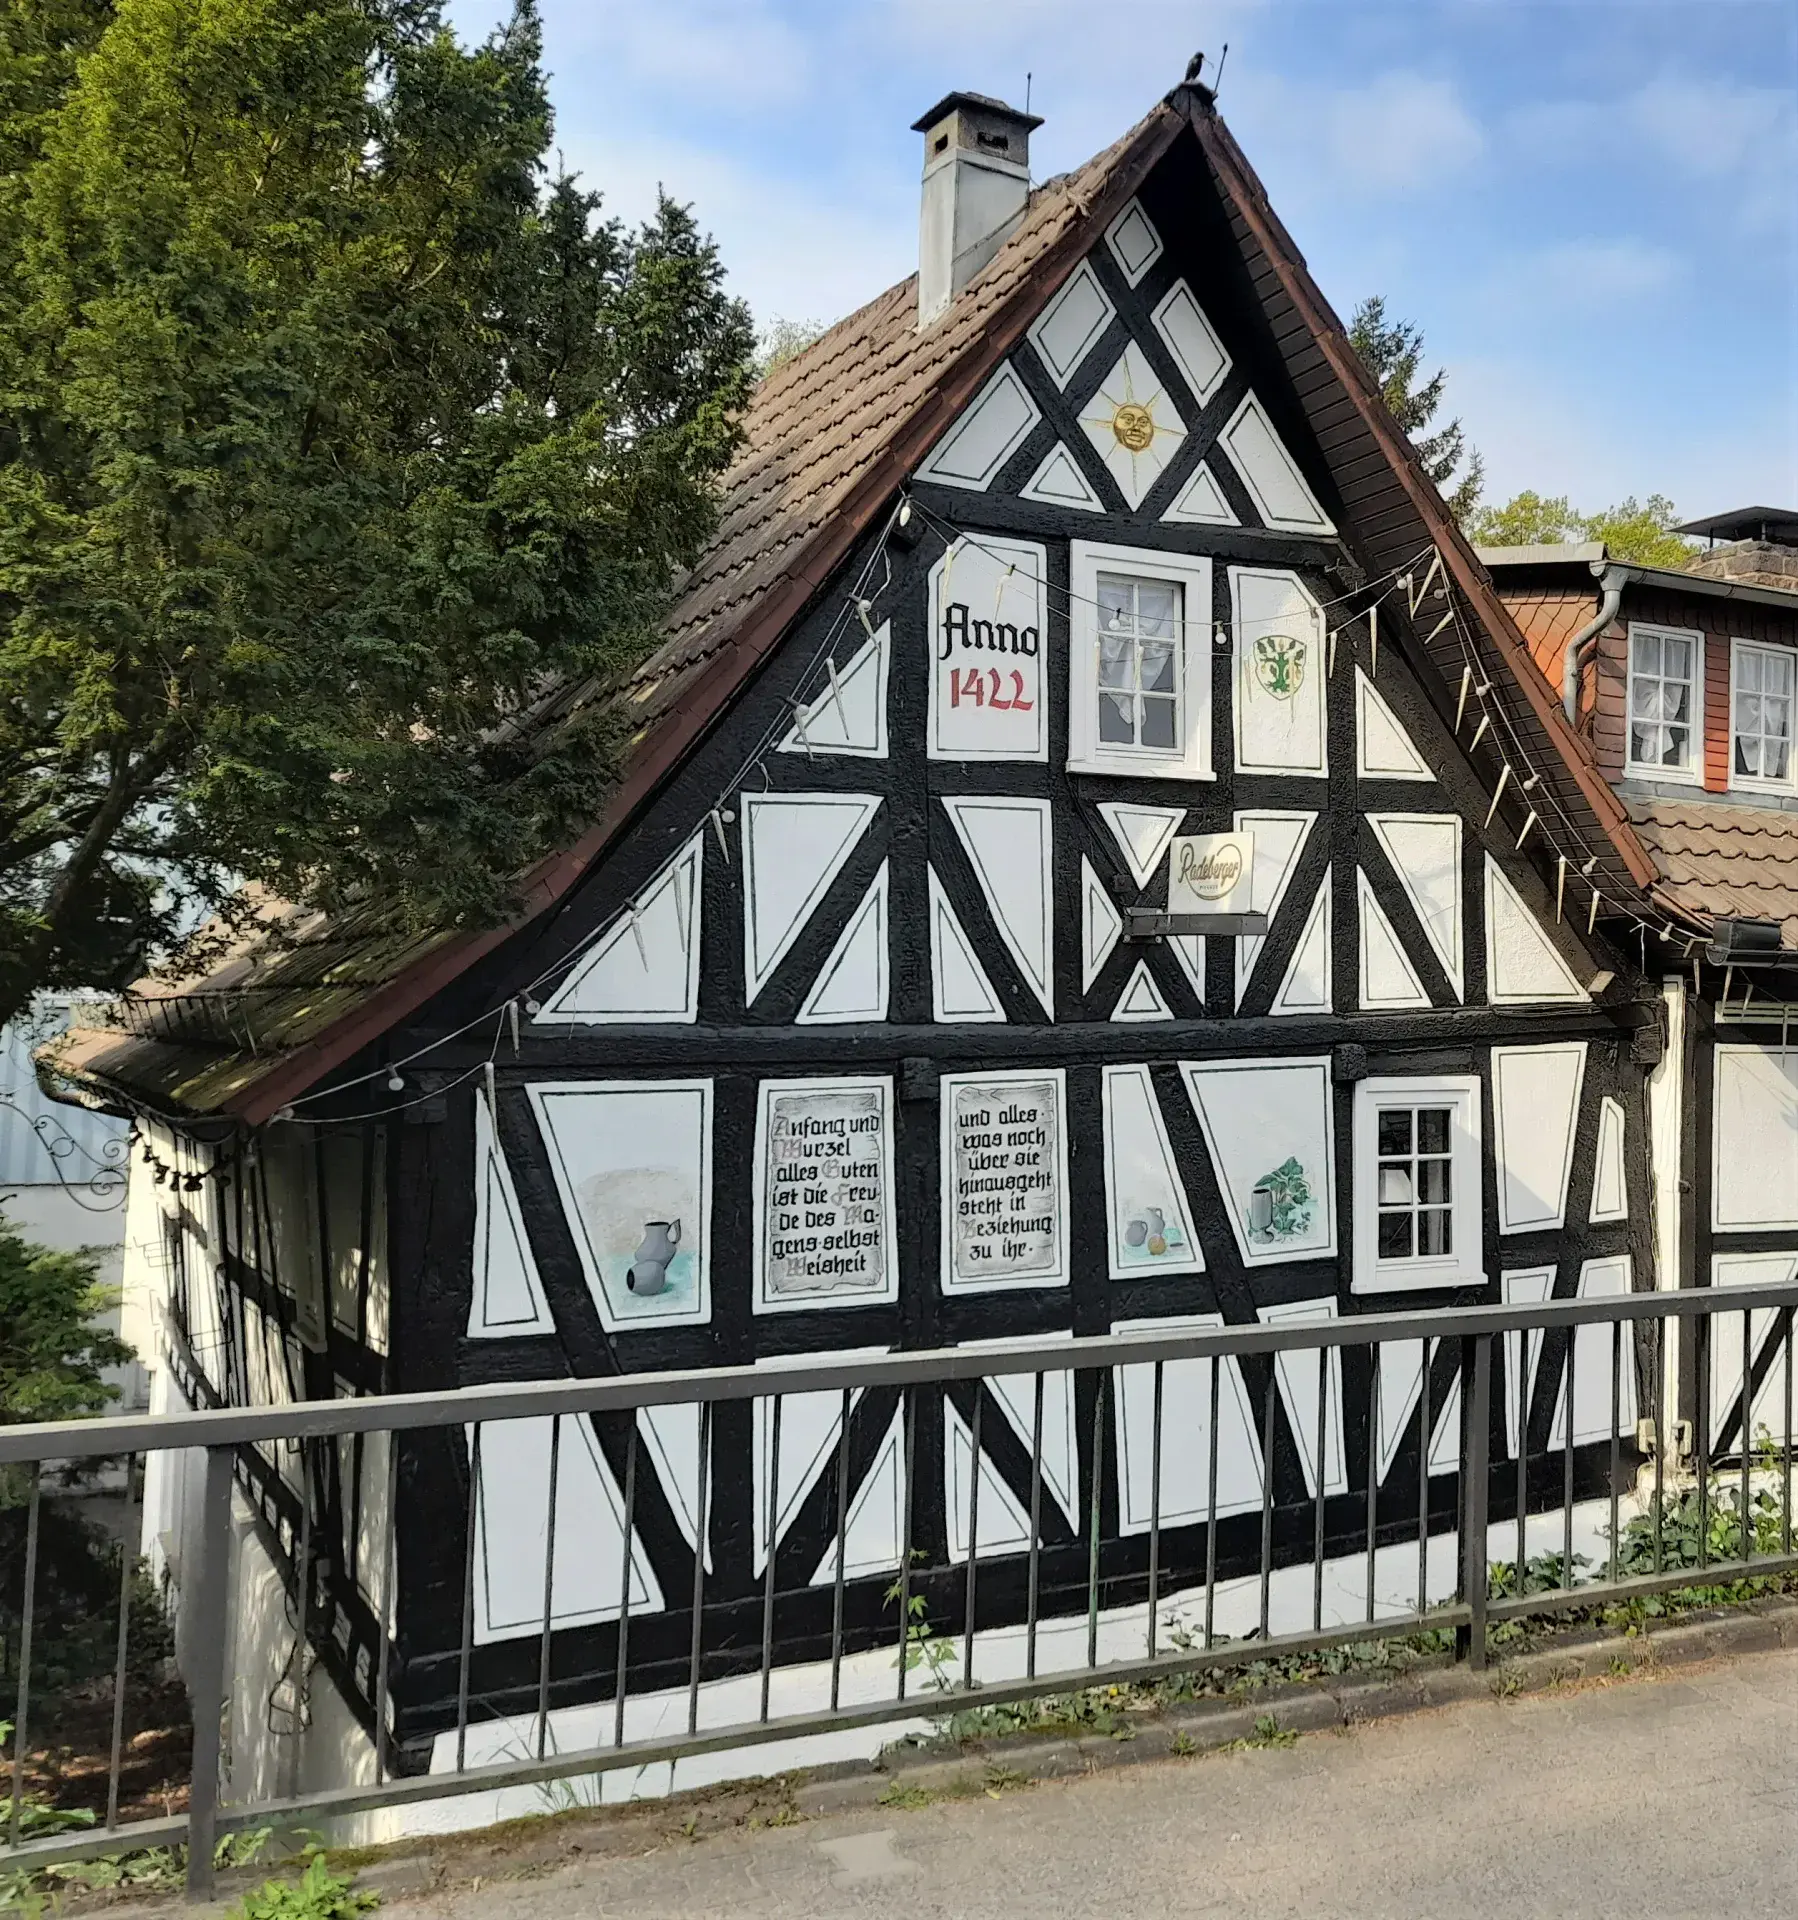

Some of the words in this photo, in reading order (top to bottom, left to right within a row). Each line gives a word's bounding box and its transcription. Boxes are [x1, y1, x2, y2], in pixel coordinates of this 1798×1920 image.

[938, 602, 1038, 661] Anno
[950, 667, 1035, 711] 1422
[1178, 842, 1239, 888] Radeberger
[773, 1115, 846, 1139] Anfang
[849, 1114, 880, 1133] und
[959, 1109, 991, 1128] und
[774, 1137, 852, 1159] Wurzel
[962, 1132, 1003, 1150] was
[1007, 1126, 1046, 1148] noch
[776, 1162, 819, 1182] alles
[821, 1158, 879, 1179] Guten
[968, 1149, 1010, 1171] über
[1014, 1145, 1041, 1167] sie
[772, 1184, 799, 1207] ist
[803, 1182, 828, 1205] die
[959, 1170, 1052, 1199] hinausgeht
[958, 1196, 1003, 1217] steht
[1010, 1190, 1026, 1212] in
[779, 1213, 800, 1231] de
[805, 1210, 837, 1229] des
[822, 1228, 880, 1251] selbst
[781, 1249, 867, 1278] Weisheit
[968, 1244, 993, 1261] zu
